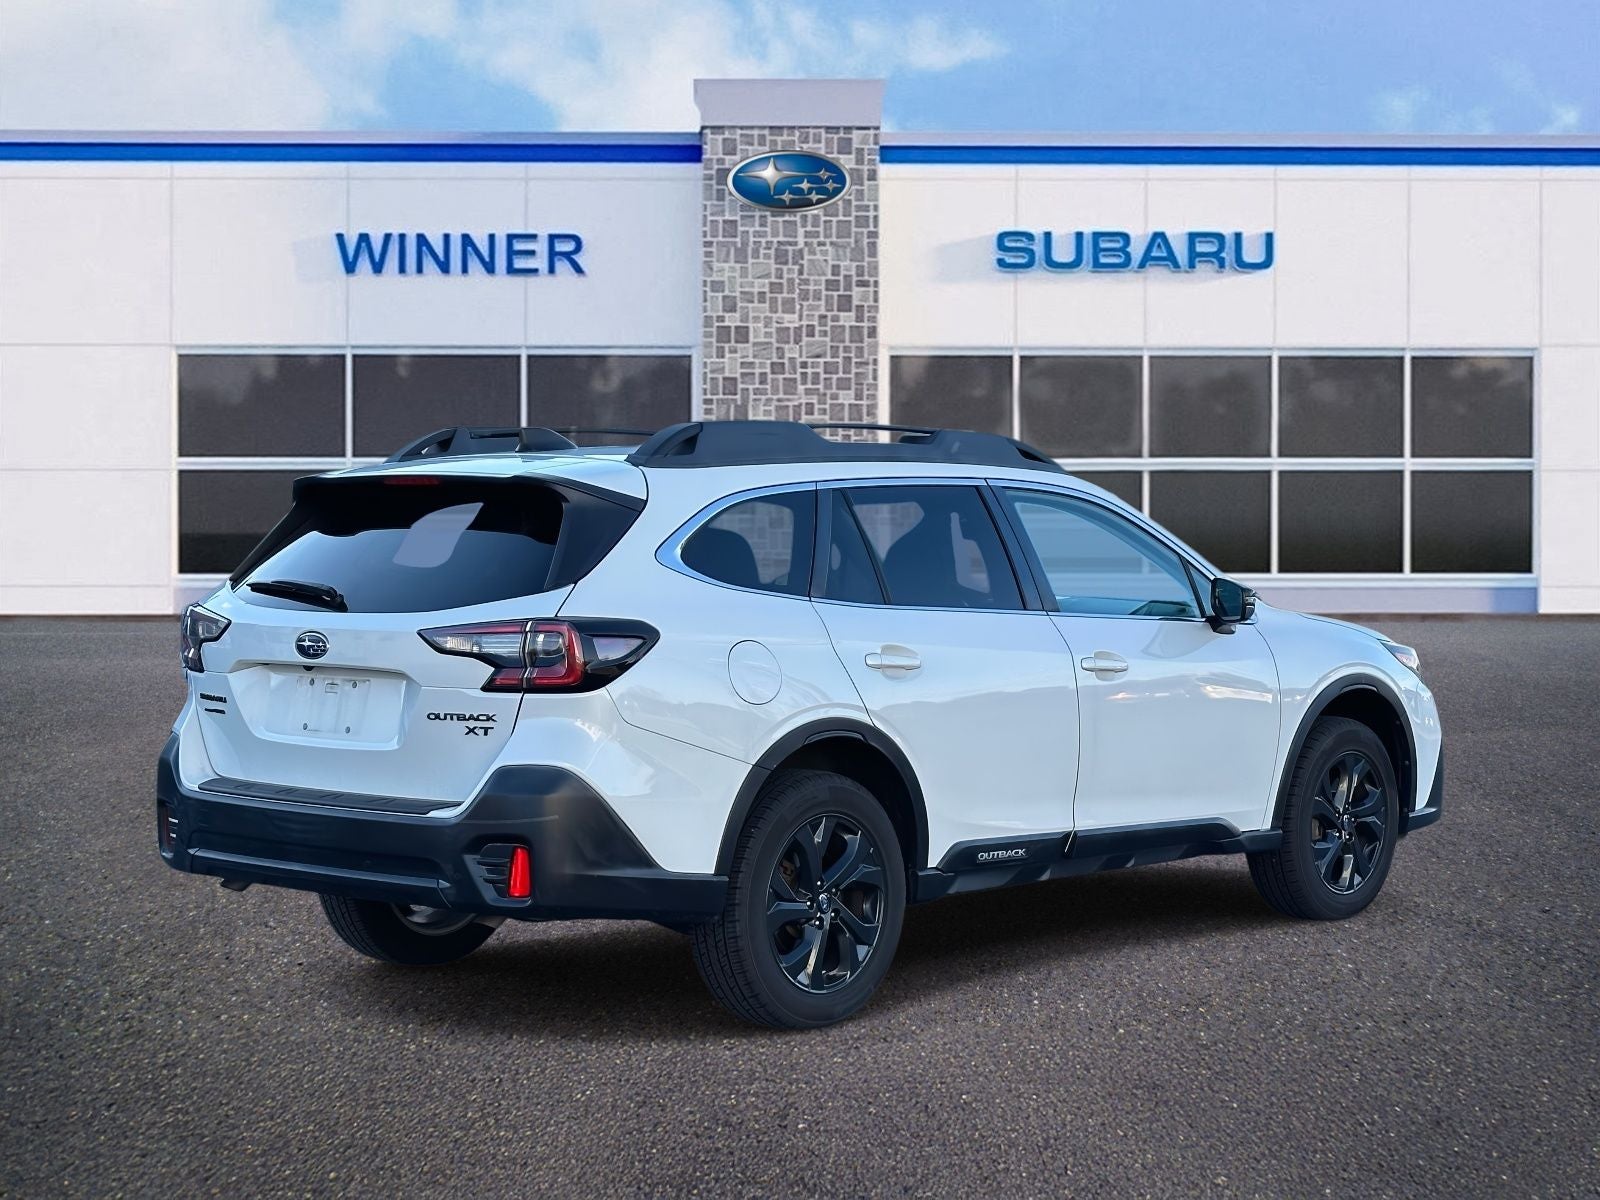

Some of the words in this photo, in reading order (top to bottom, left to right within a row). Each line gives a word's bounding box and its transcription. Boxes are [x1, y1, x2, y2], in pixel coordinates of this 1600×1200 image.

[335, 232, 586, 275] WINNER
[996, 230, 1275, 271] SUBARU
[426, 712, 498, 722] OUTBACK
[464, 725, 495, 737] XT
[977, 848, 1027, 860] OUTBACK
